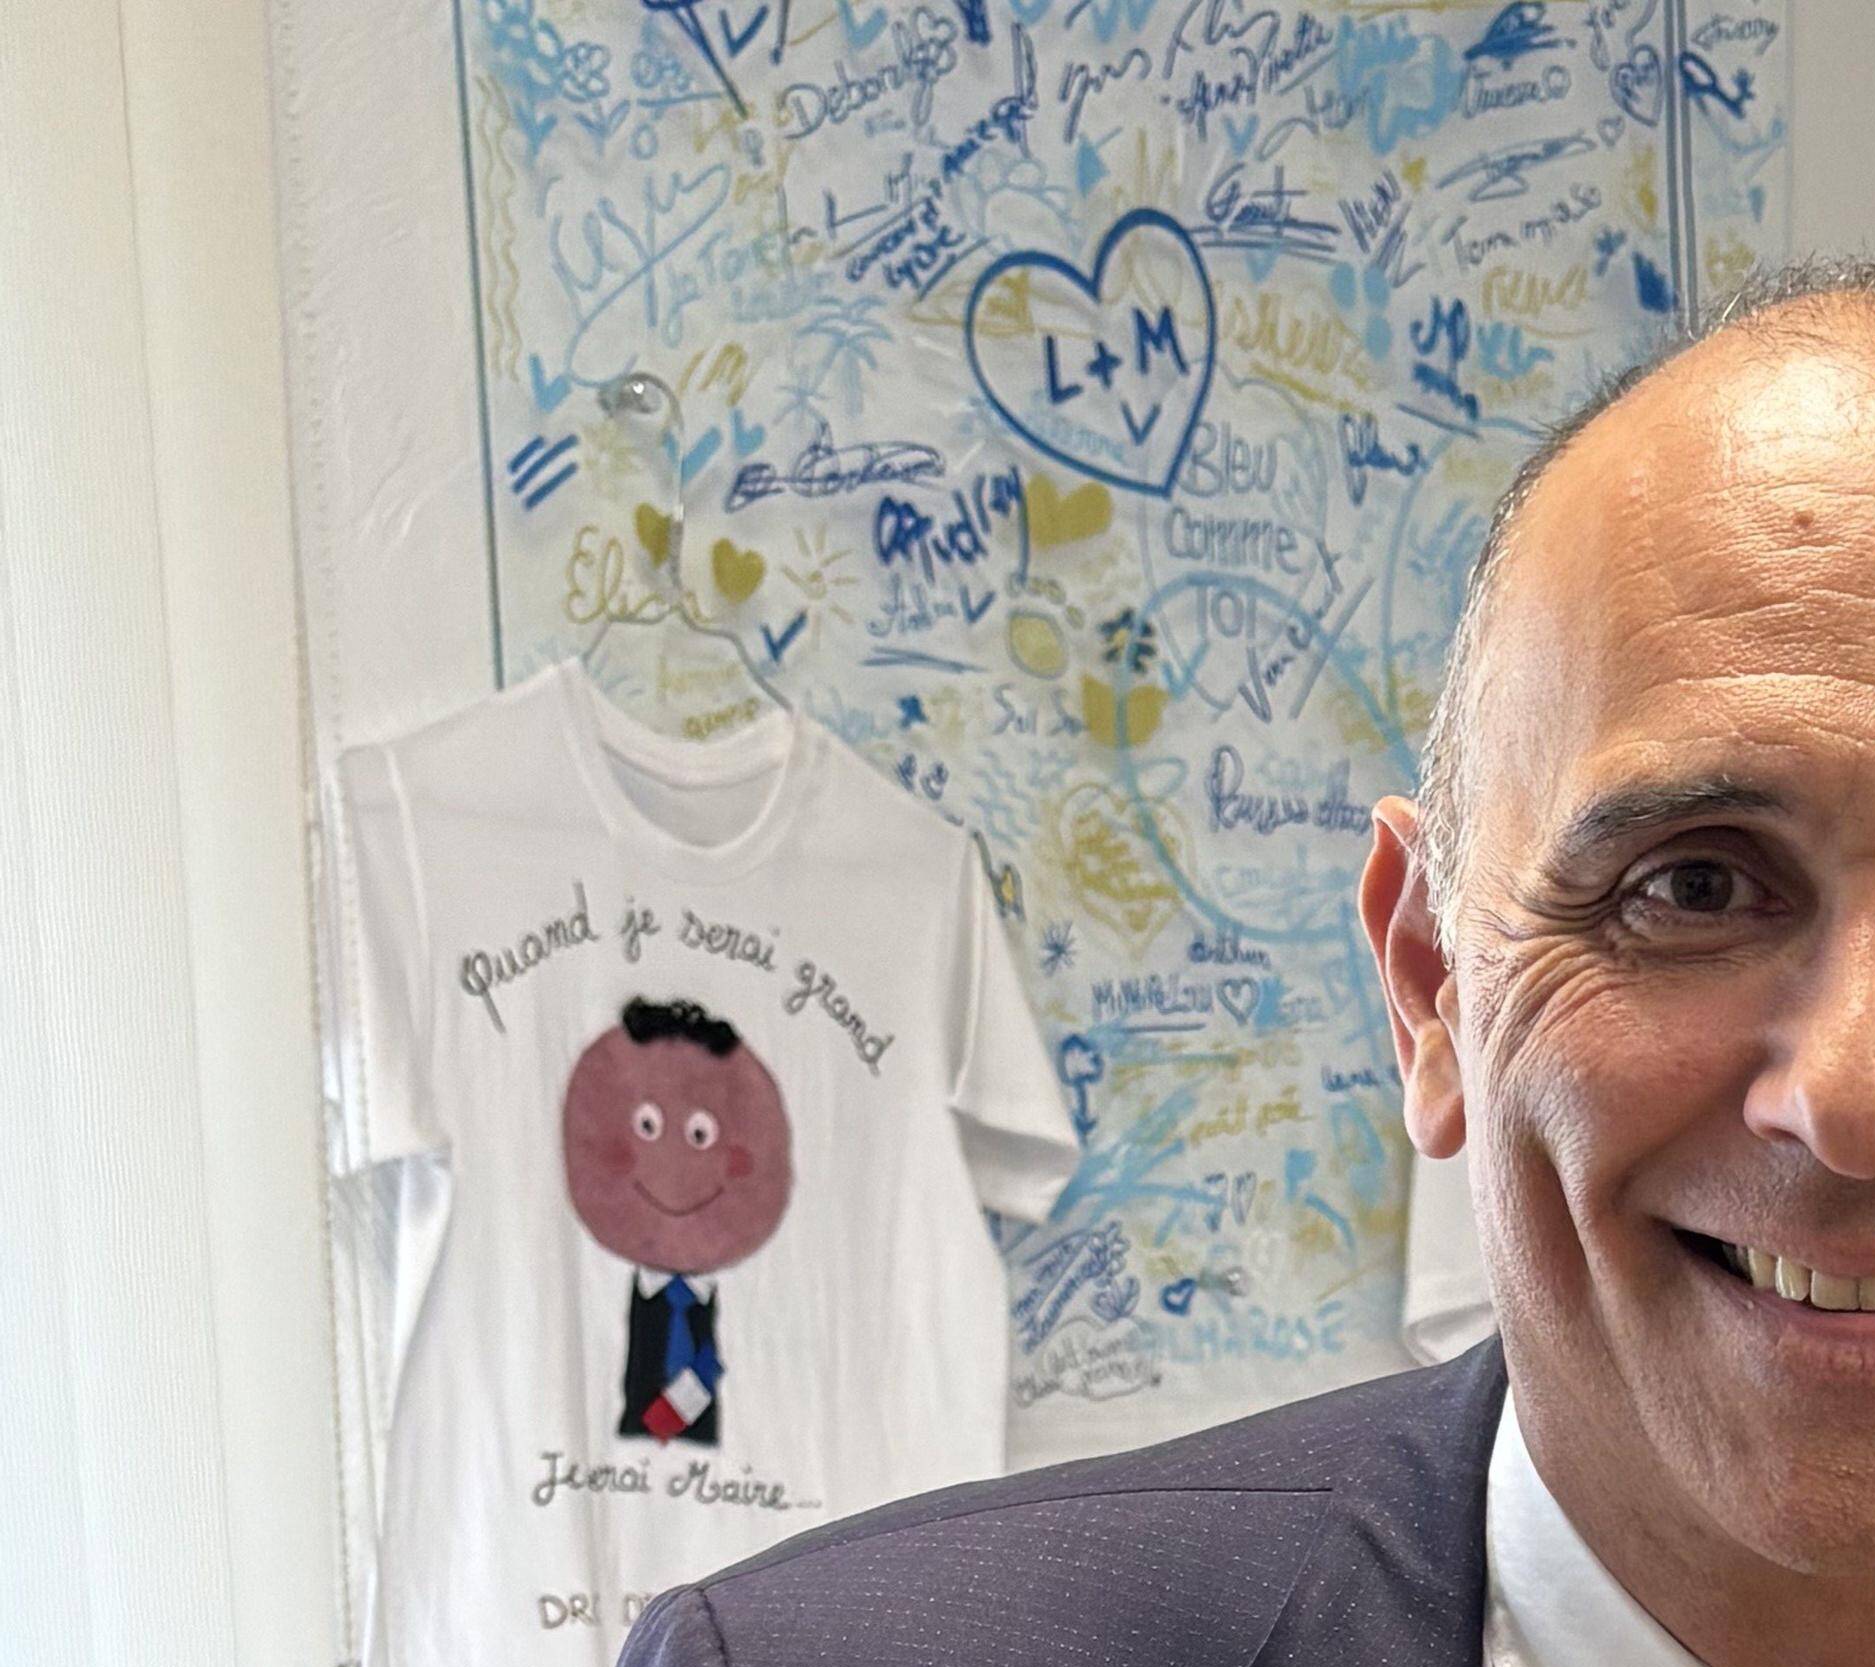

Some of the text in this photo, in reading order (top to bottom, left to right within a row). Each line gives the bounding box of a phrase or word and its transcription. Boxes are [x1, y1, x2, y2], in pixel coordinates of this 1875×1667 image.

[459, 880, 896, 1076] Quand je serai grand
